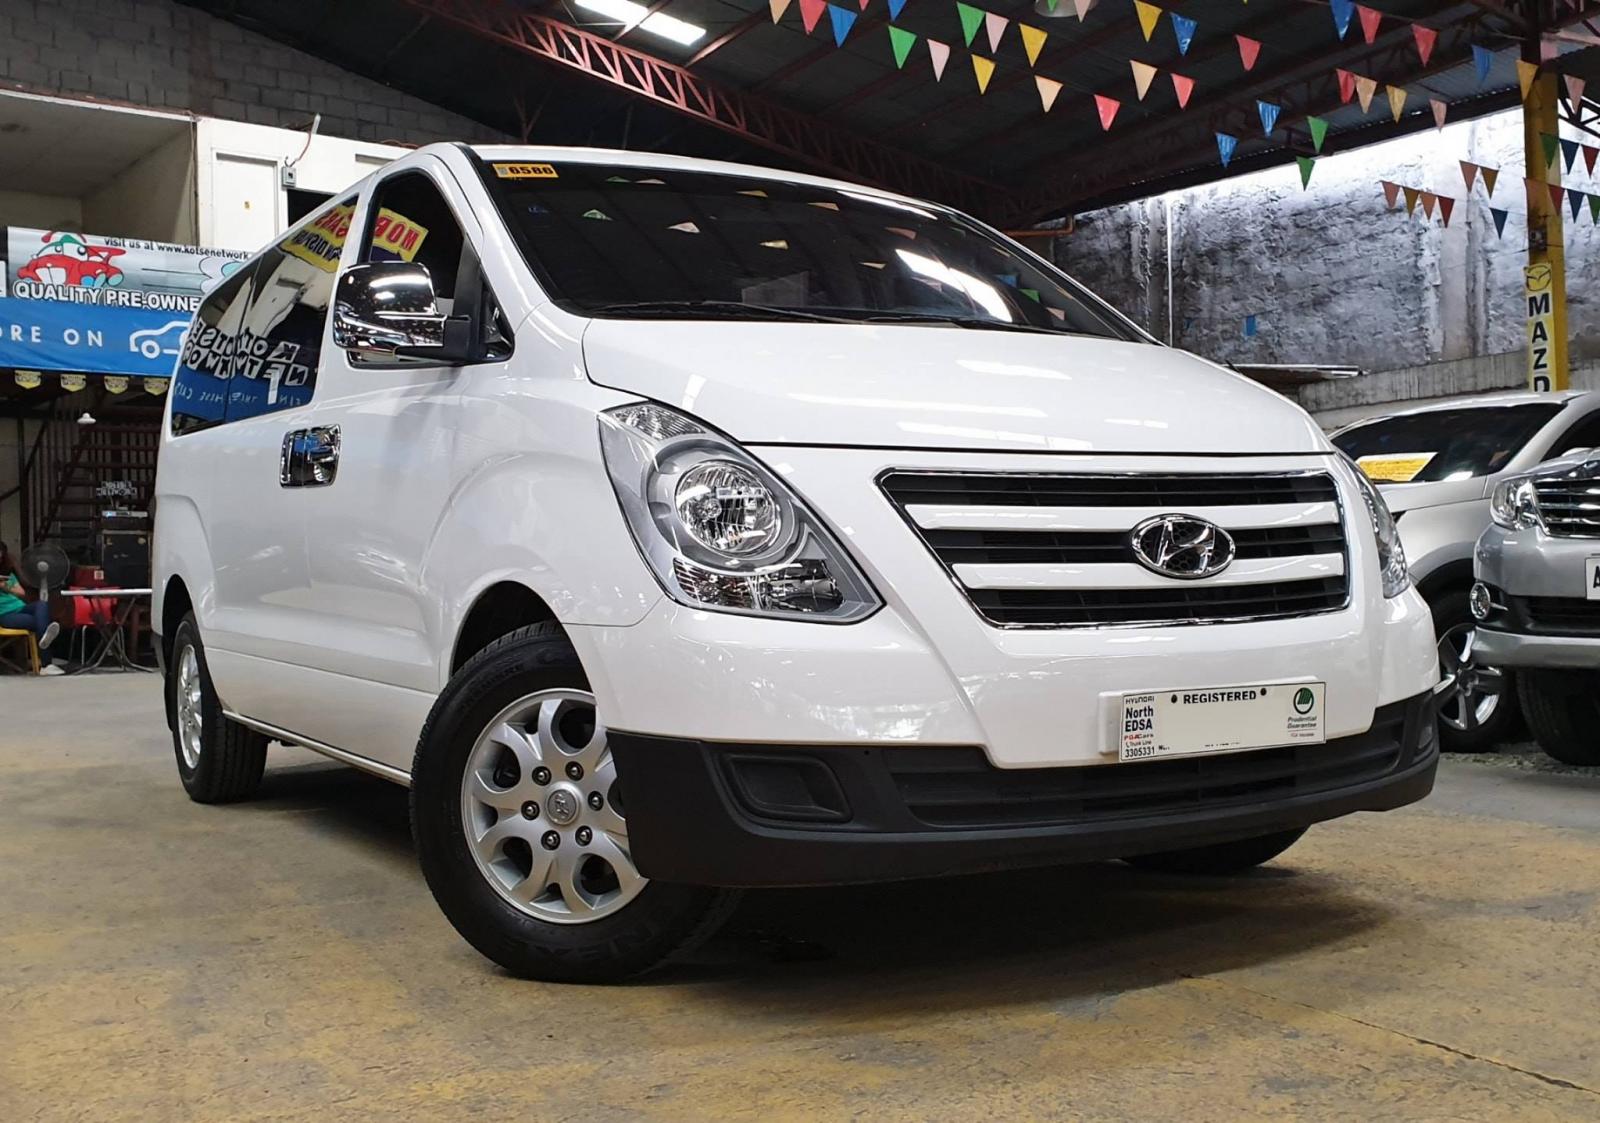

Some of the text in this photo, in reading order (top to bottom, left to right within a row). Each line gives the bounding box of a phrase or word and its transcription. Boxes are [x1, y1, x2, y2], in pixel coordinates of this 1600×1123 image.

[104, 238, 126, 247] visit
[14, 281, 201, 311] QUALITY PRE-OWNE
[0, 325, 103, 347] RE ON
[1183, 691, 1257, 704] REGISTERED
[1126, 705, 1154, 719] North
[1125, 718, 1153, 732] EDSA
[1125, 746, 1155, 758] 3305331
